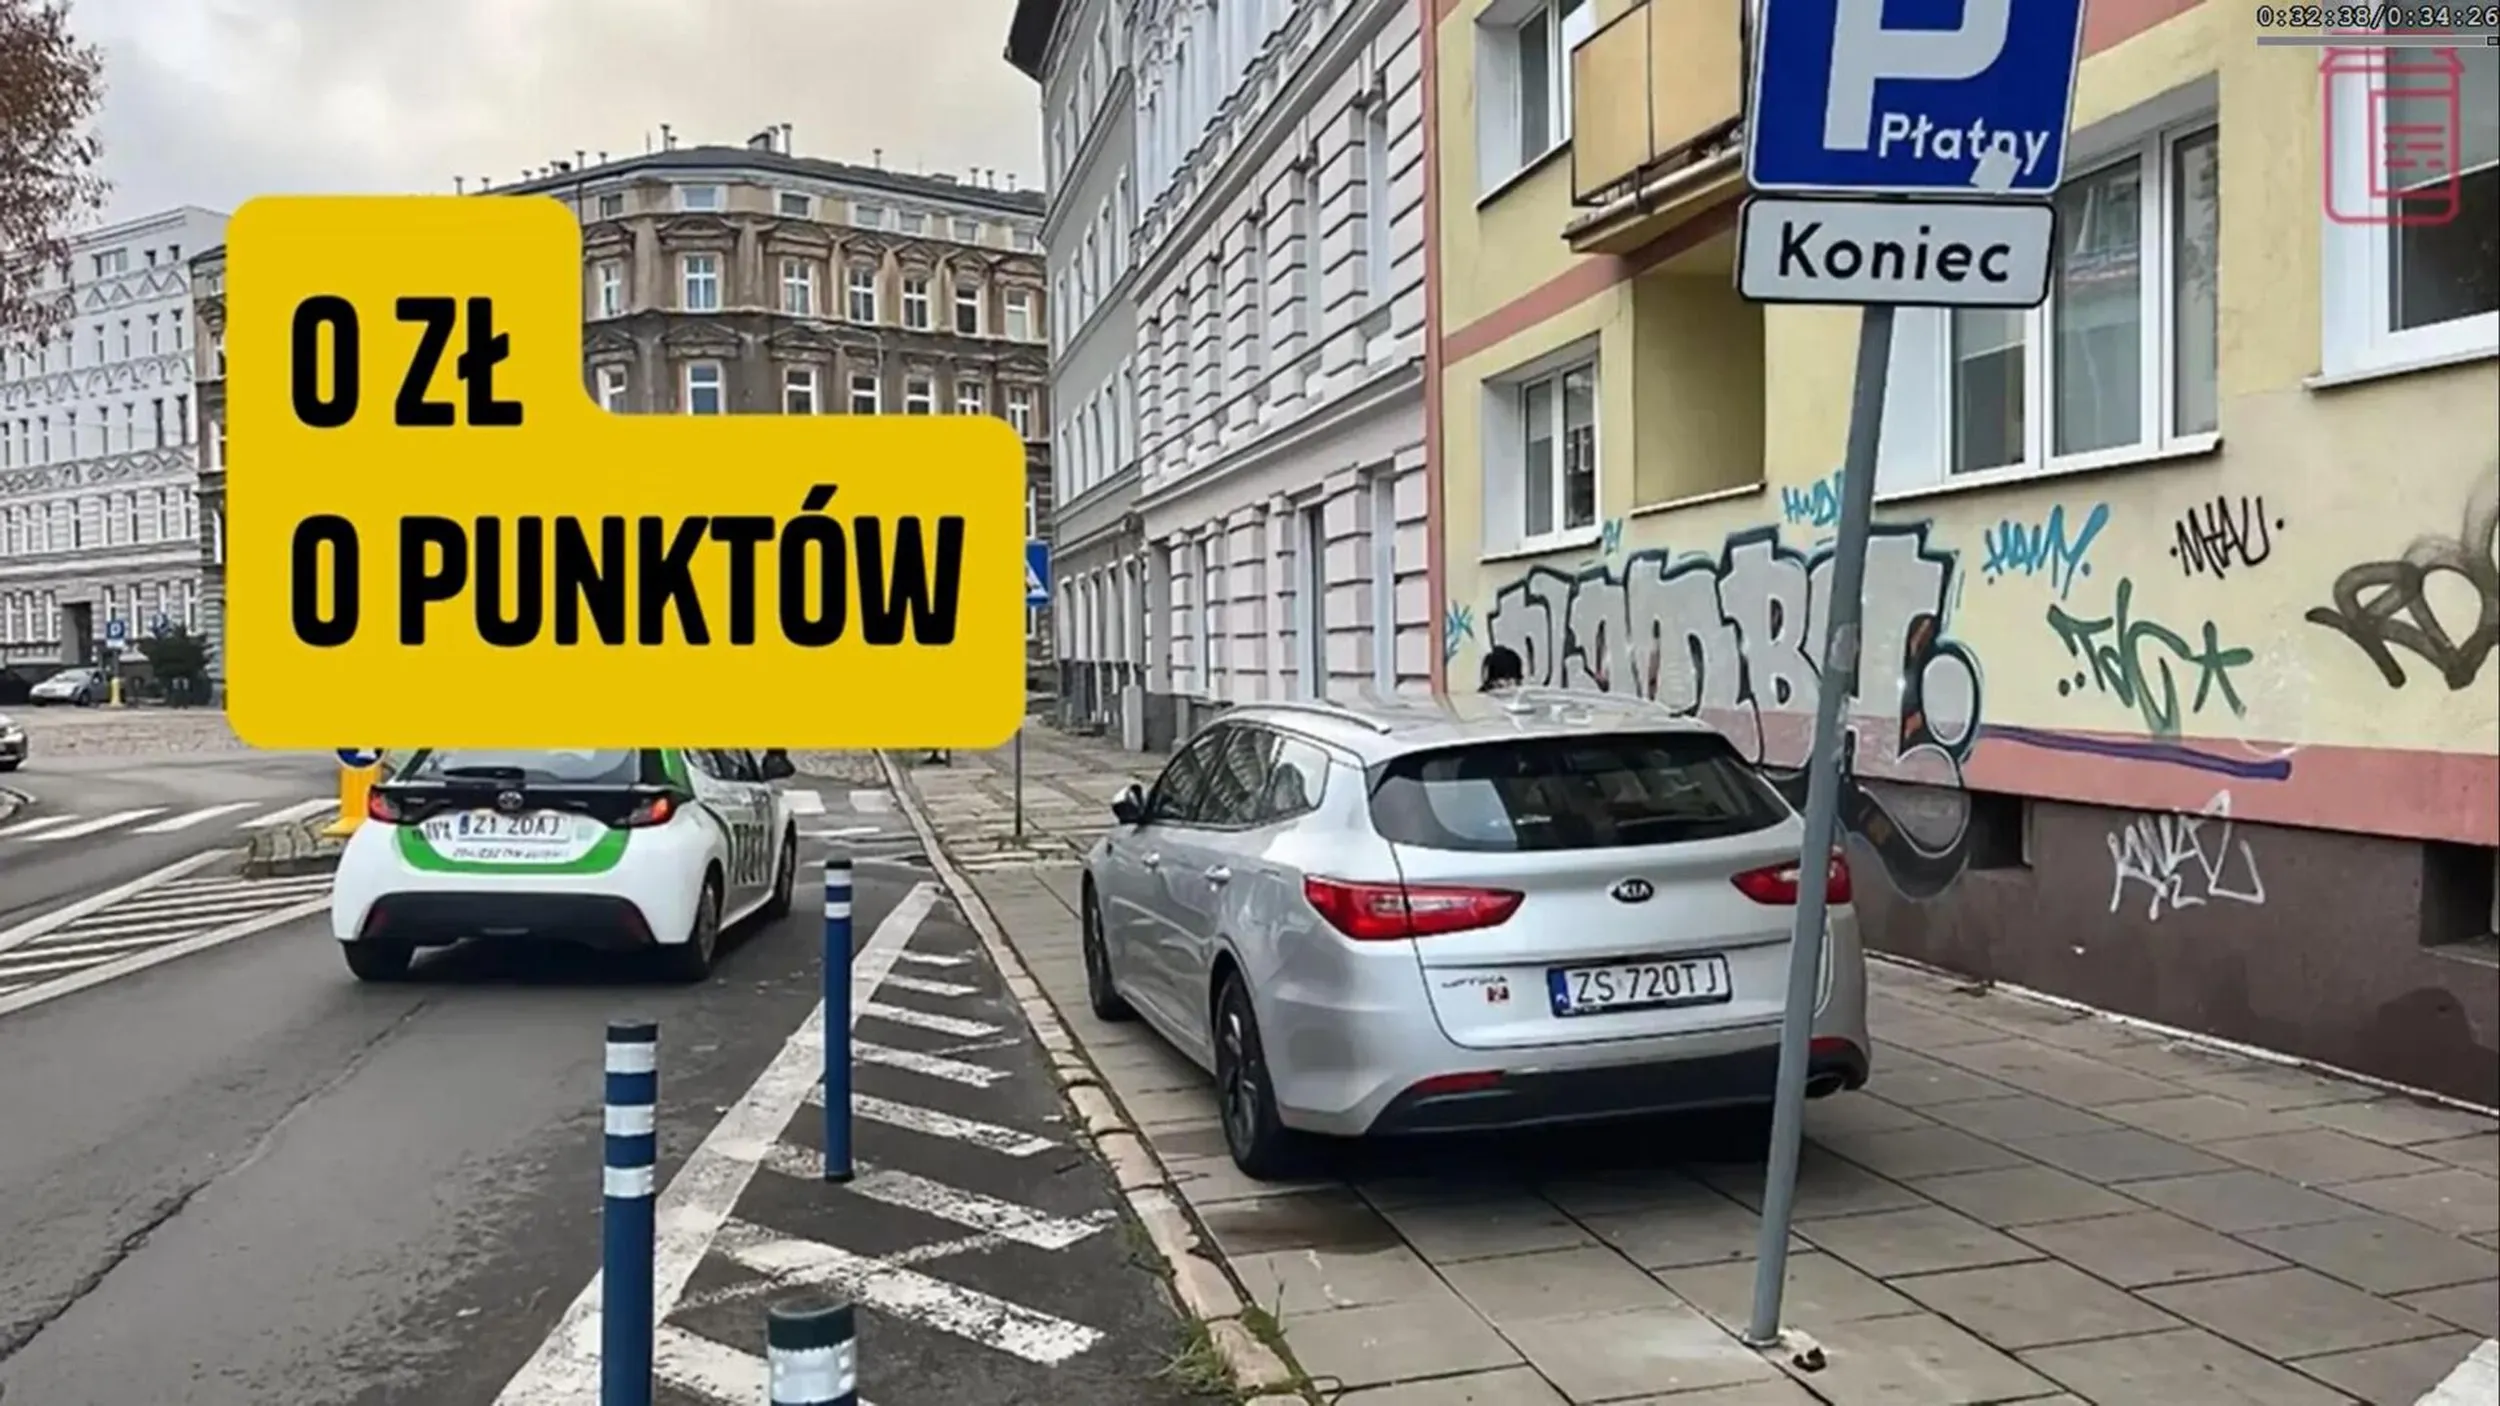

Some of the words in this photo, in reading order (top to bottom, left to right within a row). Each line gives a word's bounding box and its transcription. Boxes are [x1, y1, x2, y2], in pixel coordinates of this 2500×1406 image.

[1878, 112, 2048, 176] Płatny
[1778, 221, 2011, 283] Koniec
[1619, 882, 1649, 896] KIA
[1574, 971, 1615, 1004] ZS
[1626, 960, 1717, 999] 720TJ
